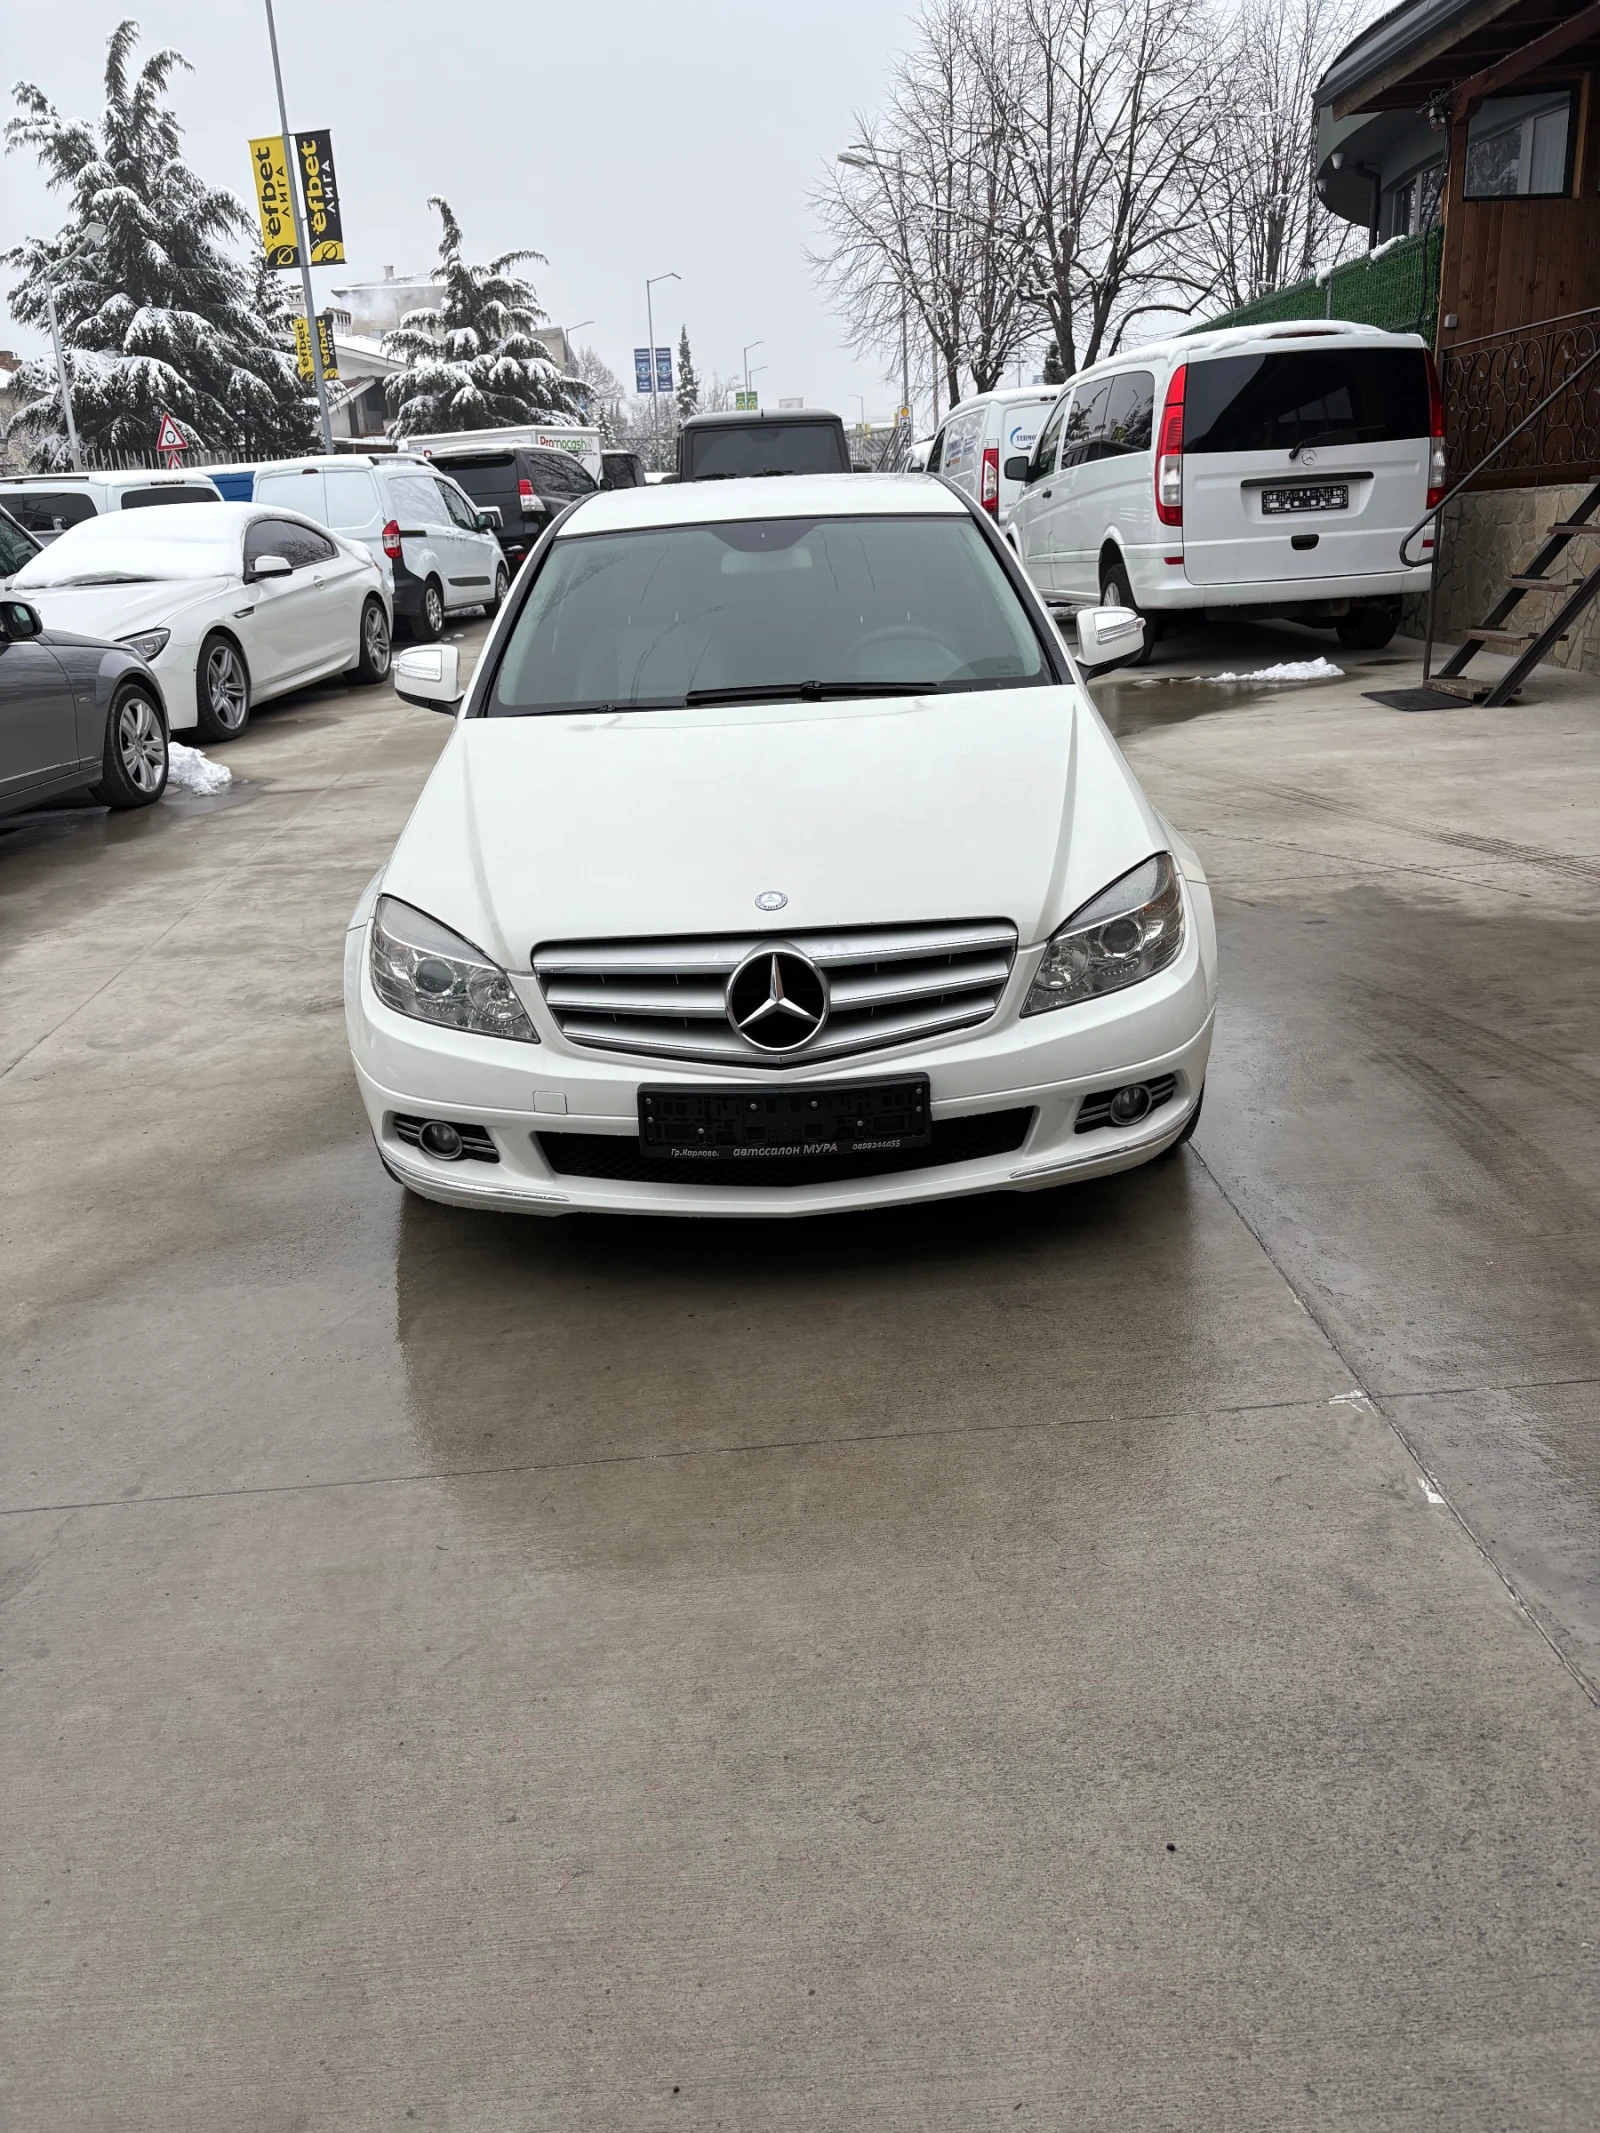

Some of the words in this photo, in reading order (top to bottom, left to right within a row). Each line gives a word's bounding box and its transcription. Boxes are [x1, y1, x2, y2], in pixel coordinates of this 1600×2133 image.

[276, 166, 290, 218] ЛИГА
[321, 160, 336, 213] ЛИГА
[540, 436, 587, 450] Promocash
[733, 1146, 800, 1157] автосалон
[803, 1143, 838, 1155] МУРА
